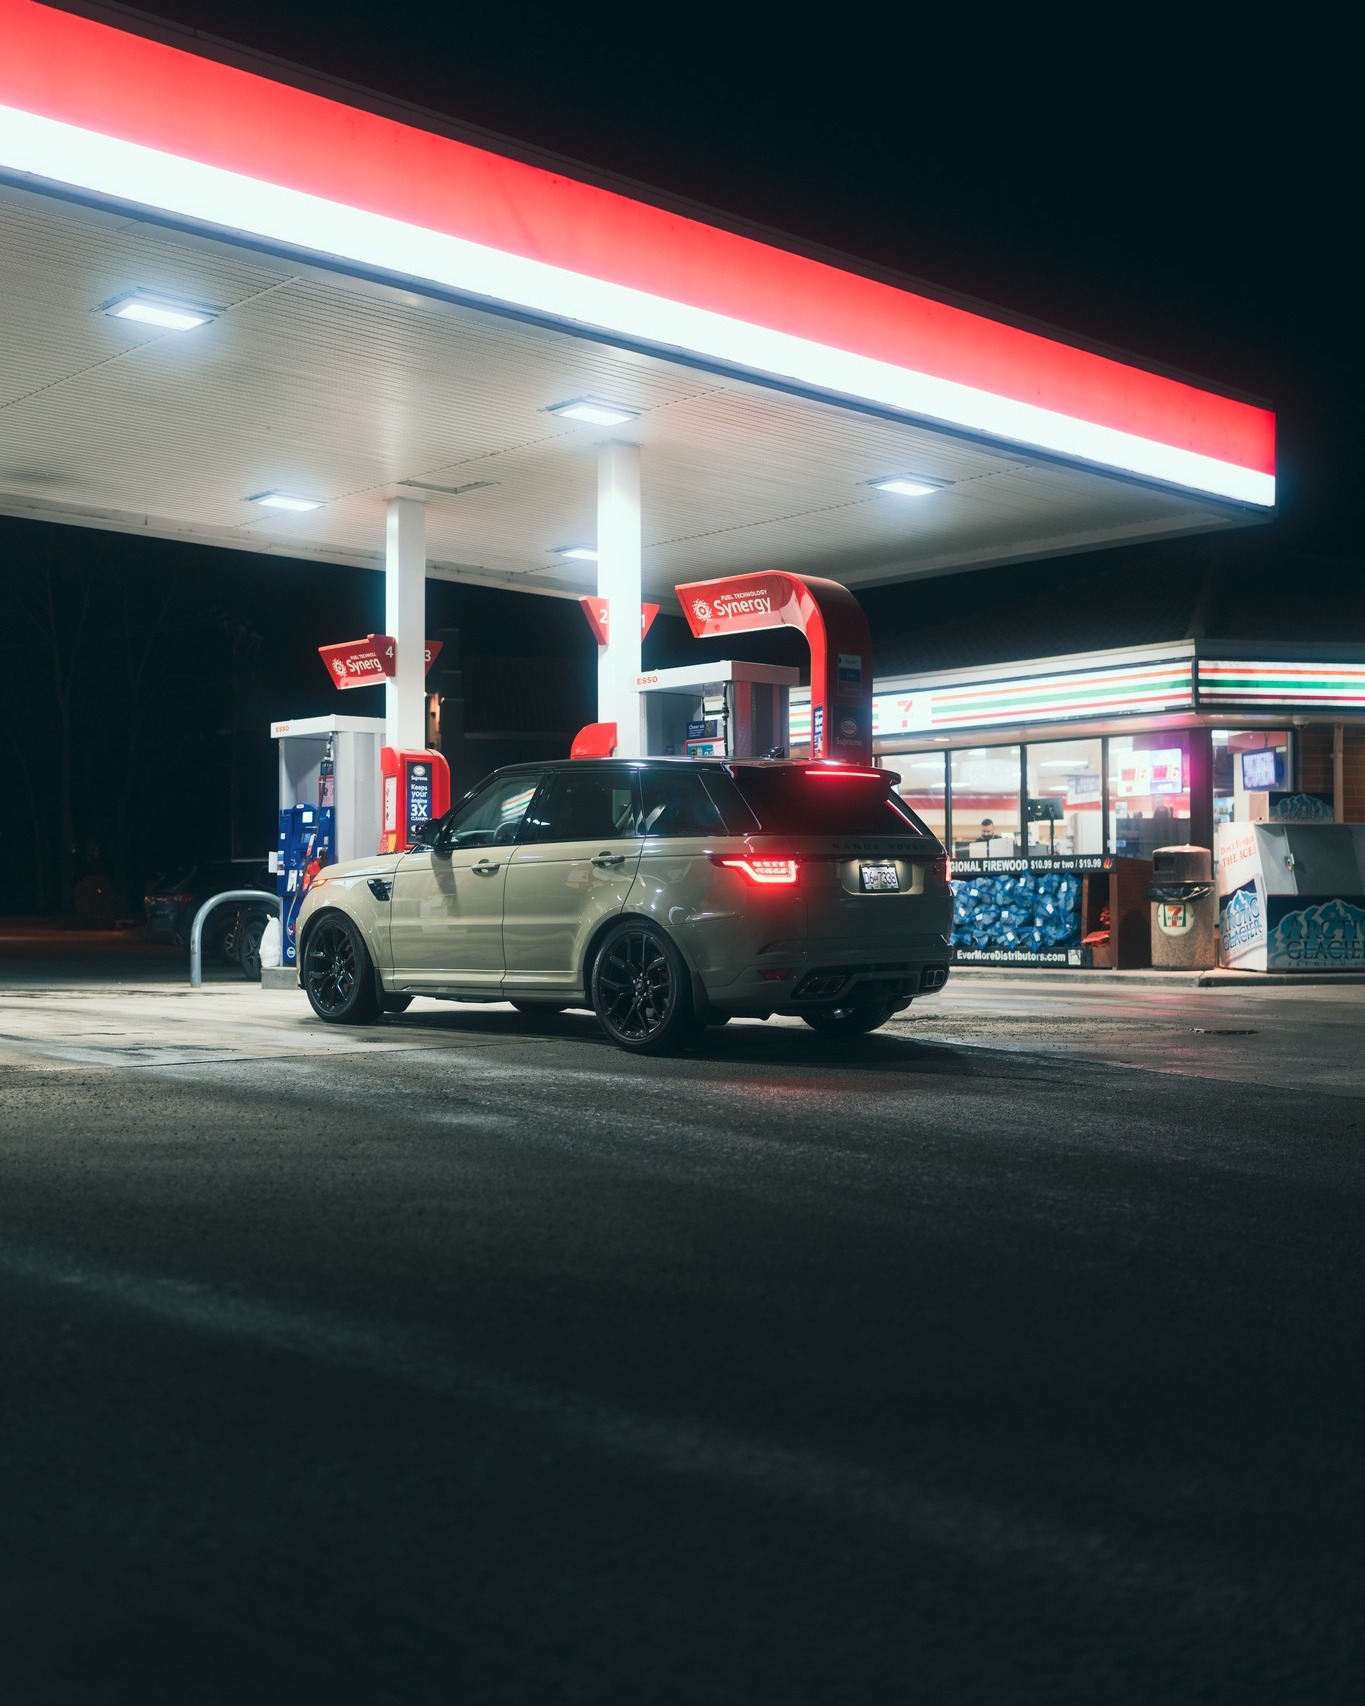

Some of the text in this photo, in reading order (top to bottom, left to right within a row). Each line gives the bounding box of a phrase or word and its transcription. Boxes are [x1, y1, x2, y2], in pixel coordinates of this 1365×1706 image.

[734, 589, 767, 599] TECHNOLOGY
[600, 608, 608, 624] 2
[713, 597, 771, 619] Synergy
[641, 613, 646, 629] 1
[385, 645, 394, 658] 4
[425, 649, 432, 662] 3
[346, 658, 383, 675] Synerg
[636, 675, 658, 685] ESSO
[897, 700, 913, 728] 7
[275, 725, 290, 733] ESSO
[325, 809, 331, 819] 4
[410, 804, 428, 817] 3X
[950, 860, 981, 872] GIONAL
[983, 859, 1028, 872] FIREWOOD
[1030, 859, 1053, 870] $10.99
[1053, 860, 1060, 869] or
[1061, 859, 1074, 869] two
[1079, 858, 1102, 869] $19.99
[1221, 852, 1239, 868] THE
[1167, 905, 1182, 927] 7
[1222, 897, 1260, 932] ARCTIC
[1222, 919, 1263, 951] GLACIER
[956, 949, 1066, 962] EverMoreDistributors.com
[1287, 940, 1365, 960] GLACIE
